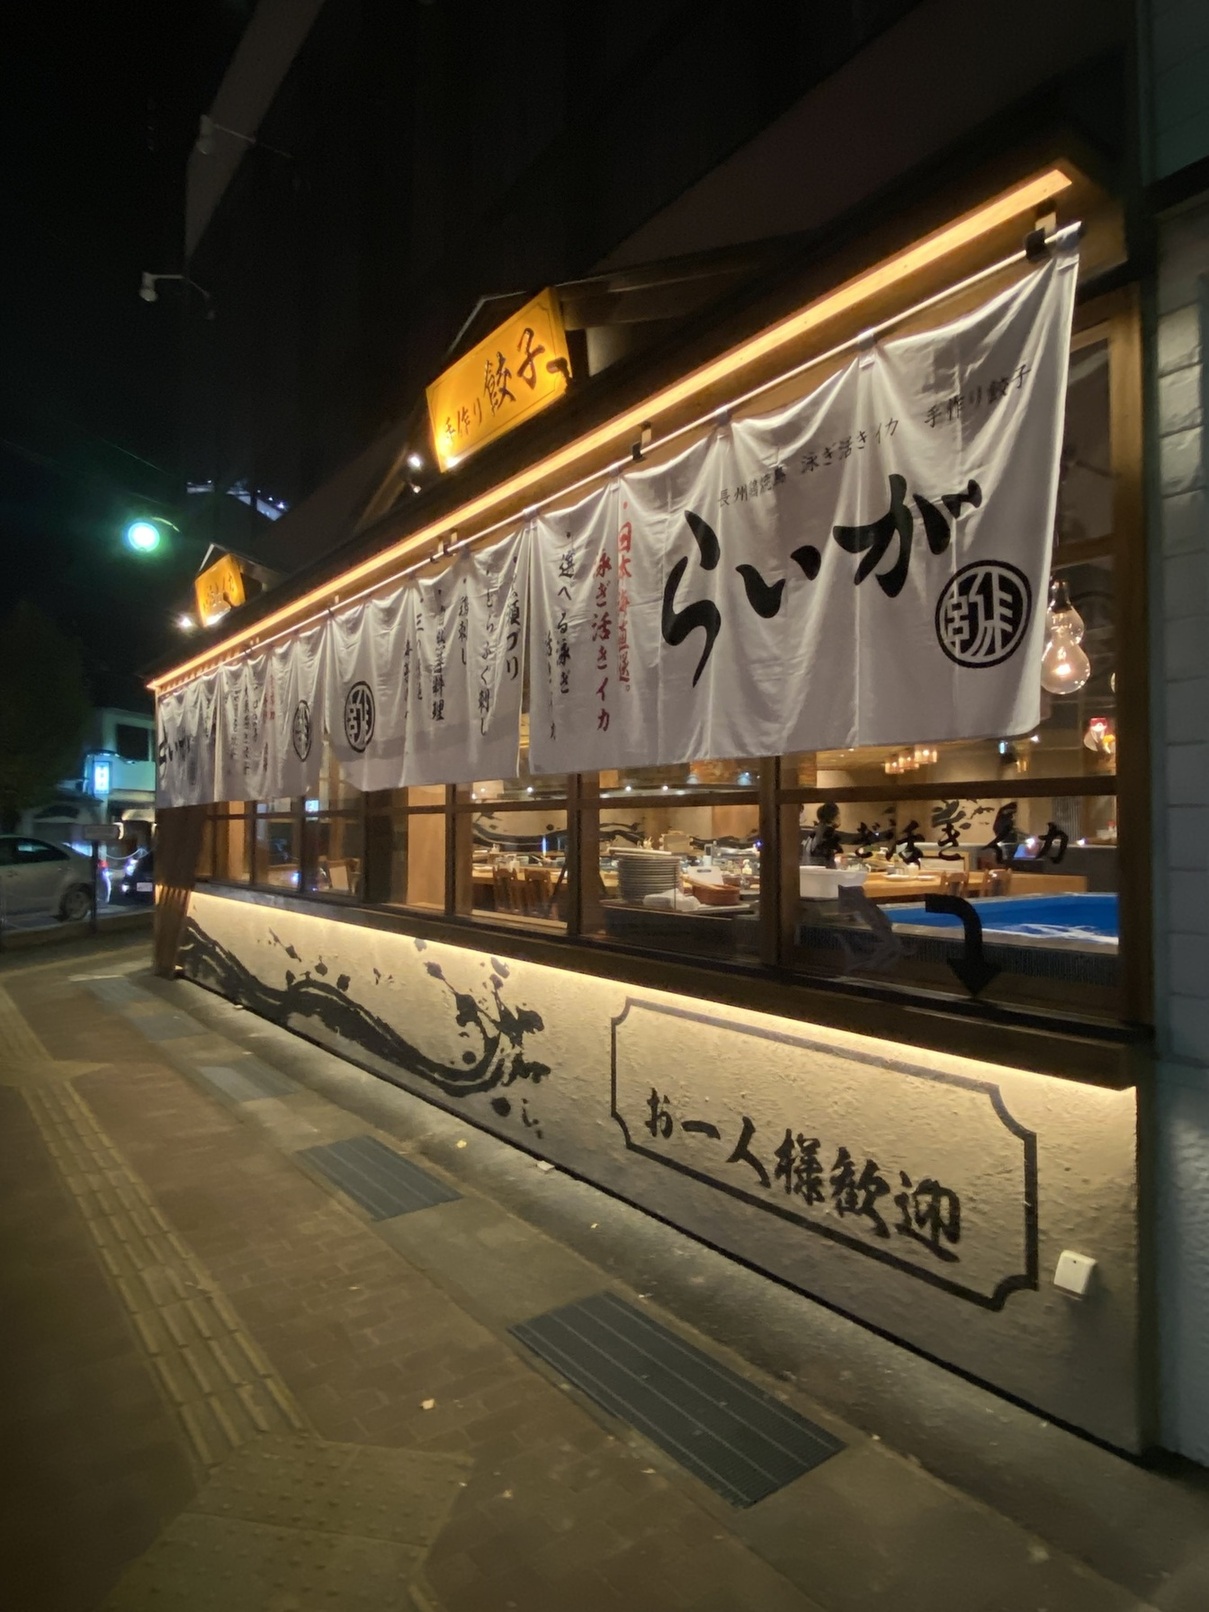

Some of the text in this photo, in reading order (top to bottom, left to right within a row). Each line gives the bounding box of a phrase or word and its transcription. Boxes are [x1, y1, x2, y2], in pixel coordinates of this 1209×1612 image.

[661, 473, 983, 689] らいが
[643, 1087, 963, 1263] お一人様歓迎
